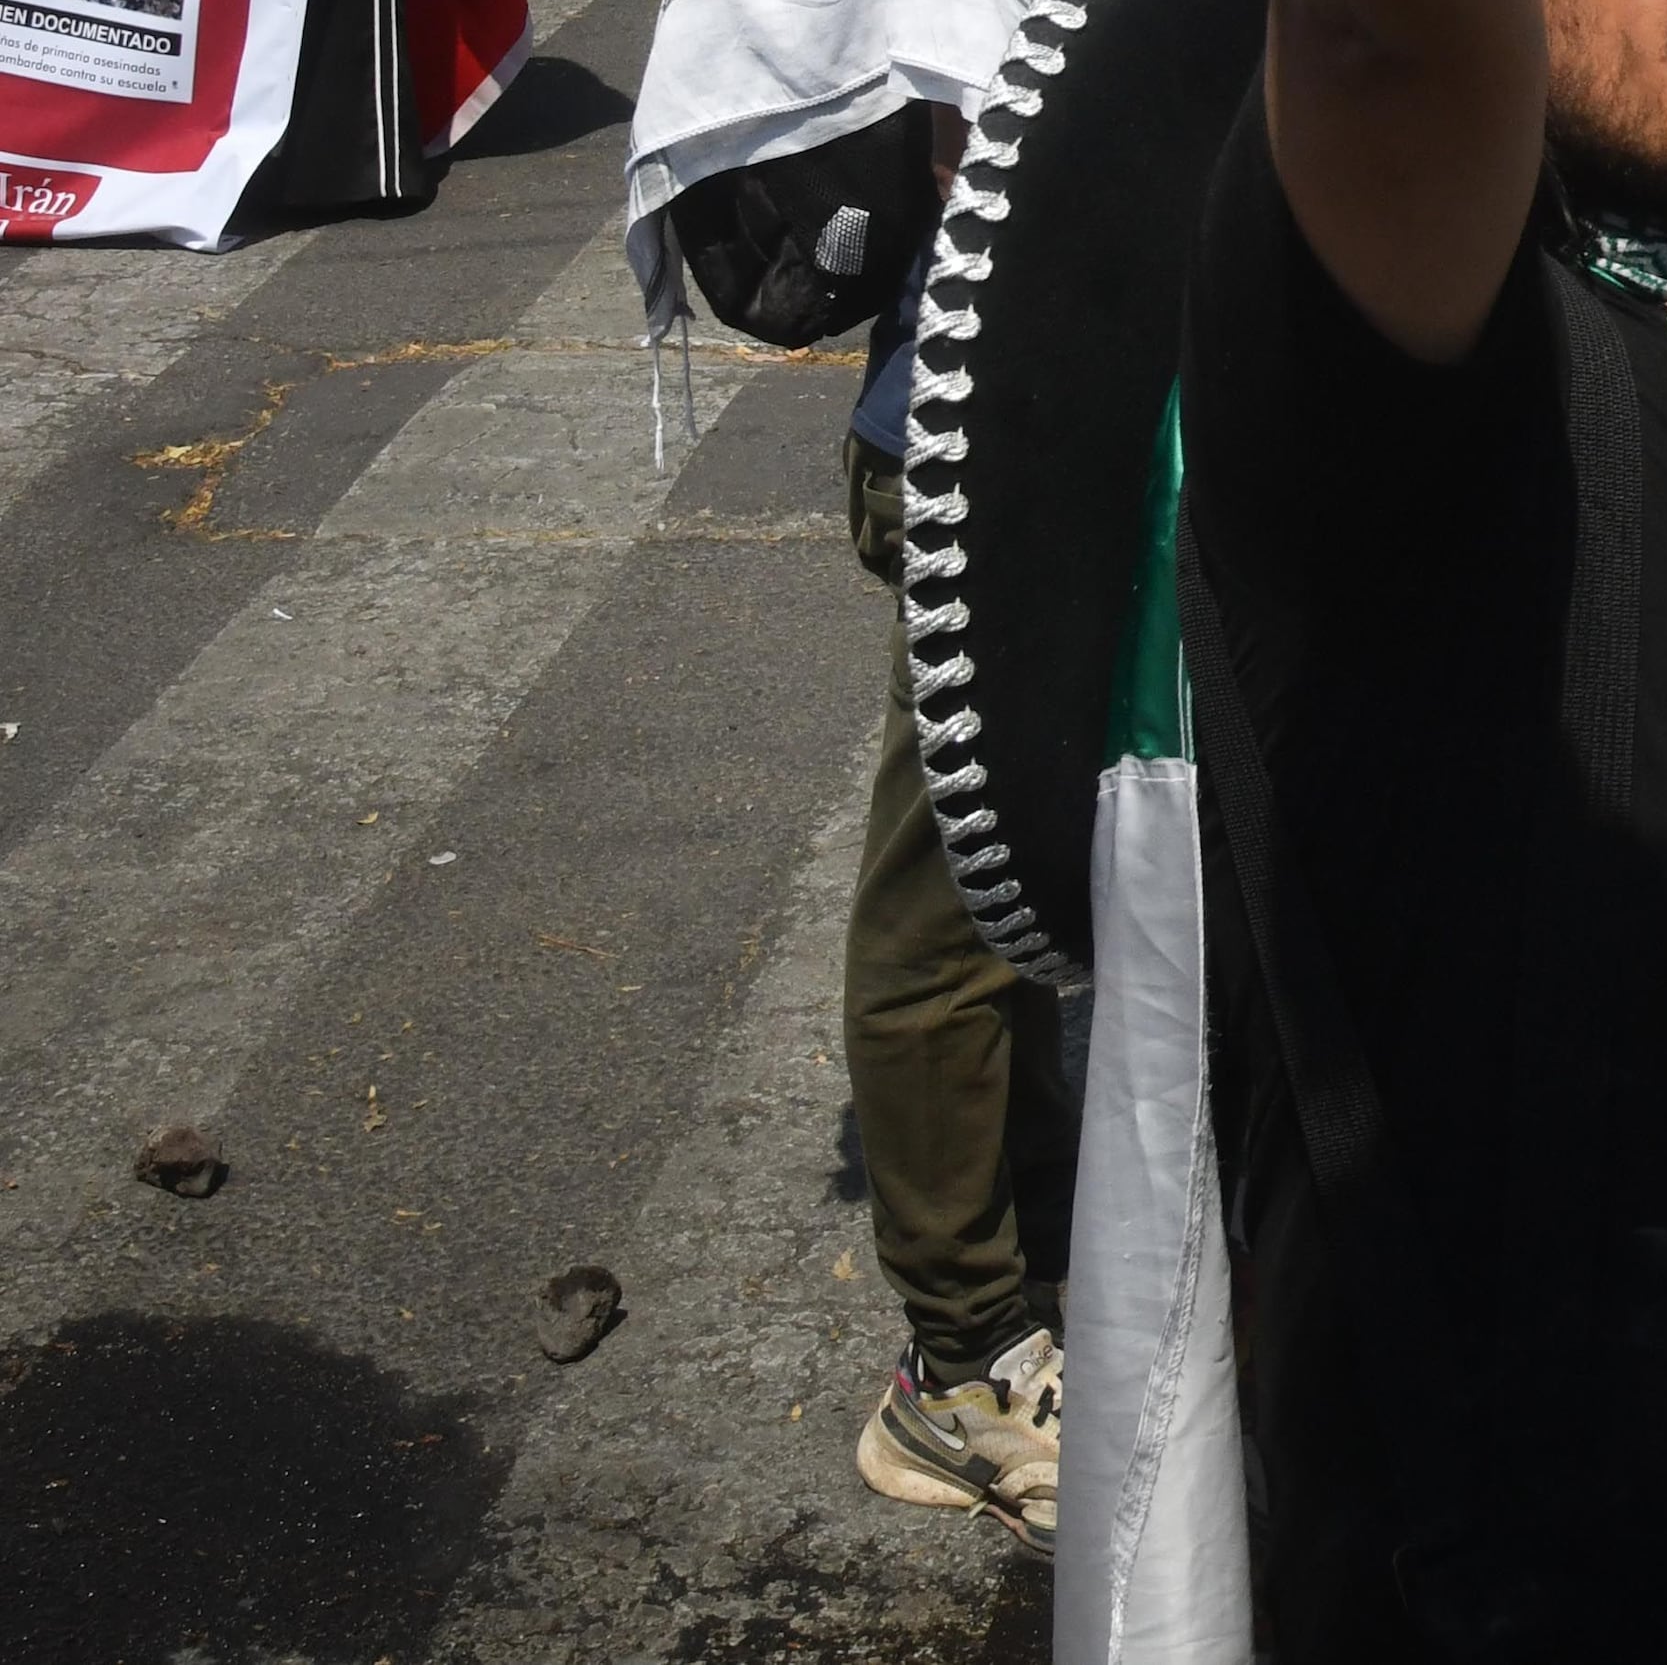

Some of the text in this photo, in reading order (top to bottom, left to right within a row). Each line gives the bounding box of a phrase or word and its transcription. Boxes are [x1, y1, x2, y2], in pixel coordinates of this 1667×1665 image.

[0, 3, 171, 53] EN DOCUMENTADO
[0, 53, 166, 92] ombardeo contra su escuela
[24, 39, 39, 52] de
[42, 45, 90, 64] primaria
[93, 57, 161, 76] asesinadas
